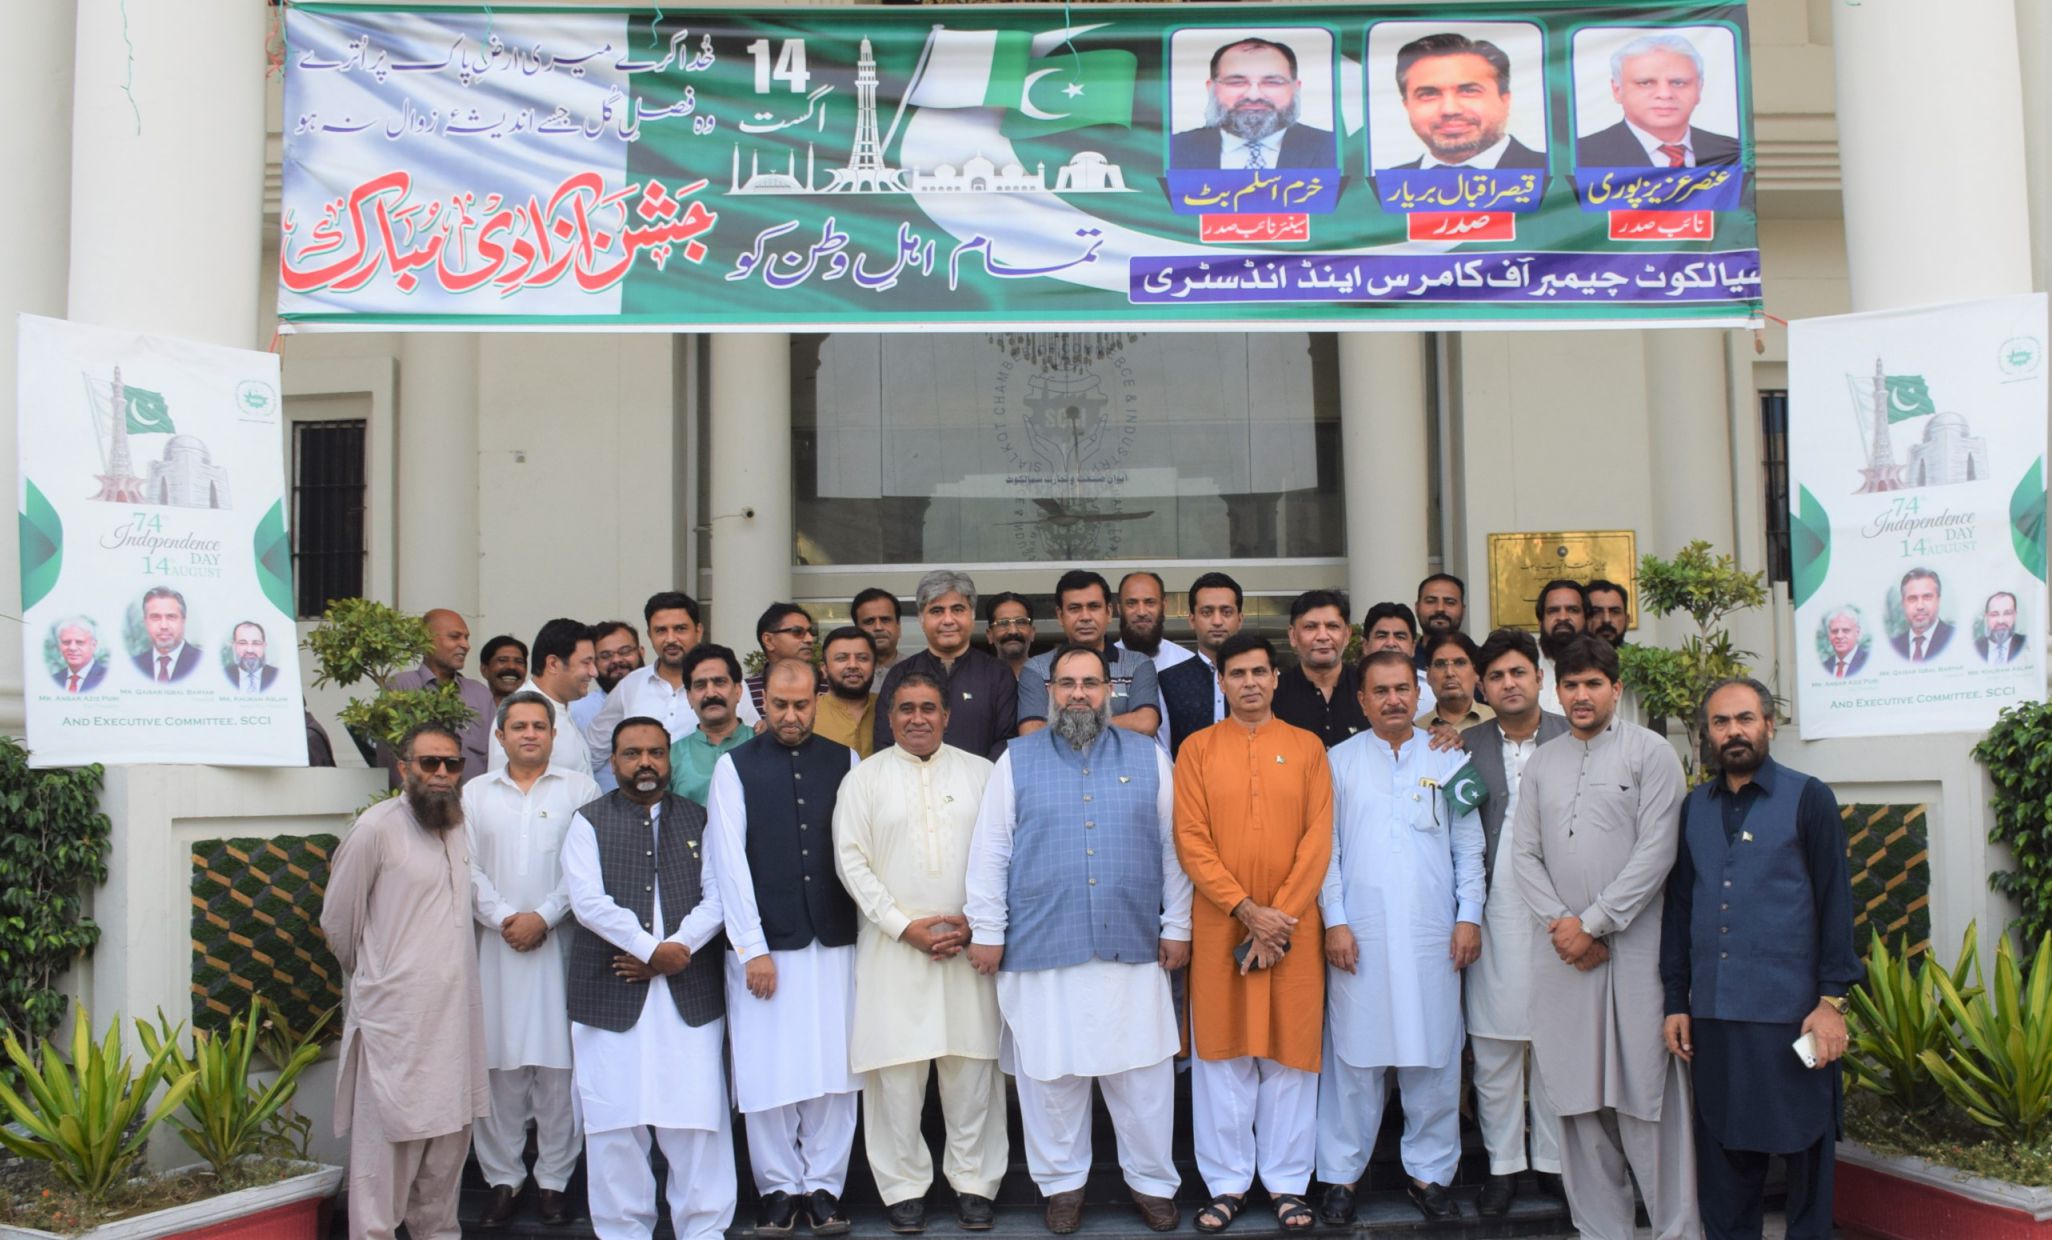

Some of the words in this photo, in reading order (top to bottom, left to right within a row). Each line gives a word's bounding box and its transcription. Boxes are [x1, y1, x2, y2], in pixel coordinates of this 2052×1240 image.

[366, 50, 388, 84] پر
[391, 33, 471, 86] پاک
[522, 42, 613, 77] میری
[615, 29, 688, 72] کرے
[746, 38, 811, 94] 14
[294, 113, 318, 135] ہو
[385, 97, 440, 140] زوال
[537, 104, 582, 134] جسے
[692, 114, 716, 135] وہ
[739, 84, 835, 133] اگست
[322, 117, 380, 134] نہ
[1184, 183, 1231, 207] بٹ
[1233, 171, 1283, 213] اسلم
[1284, 177, 1323, 207] خرم
[1437, 173, 1496, 208] اقبال
[1483, 174, 1536, 208] قیصر
[1587, 172, 1643, 209] پوری
[1641, 174, 1694, 204] عزیز
[1676, 170, 1731, 203] عنصر
[1203, 221, 1238, 235] صدر
[1433, 214, 1491, 235] صدر
[1618, 221, 1656, 234] صدر
[1657, 213, 1704, 238] نائب
[724, 220, 800, 281] کو
[763, 216, 850, 289] وطن
[949, 228, 1104, 292] تمام
[1143, 258, 1287, 298] انڈسٹری
[1297, 258, 1362, 294] اینڈ
[1367, 259, 1484, 296] کامرس
[1487, 257, 1536, 288] آف
[1528, 269, 1630, 297] چیمبر
[100, 522, 220, 555] Independence
[1861, 507, 1975, 538] Independence
[1946, 525, 1976, 540] DAY
[191, 552, 221, 565] DAY
[1986, 686, 2016, 698] SCCI
[240, 716, 272, 726] SCCI
